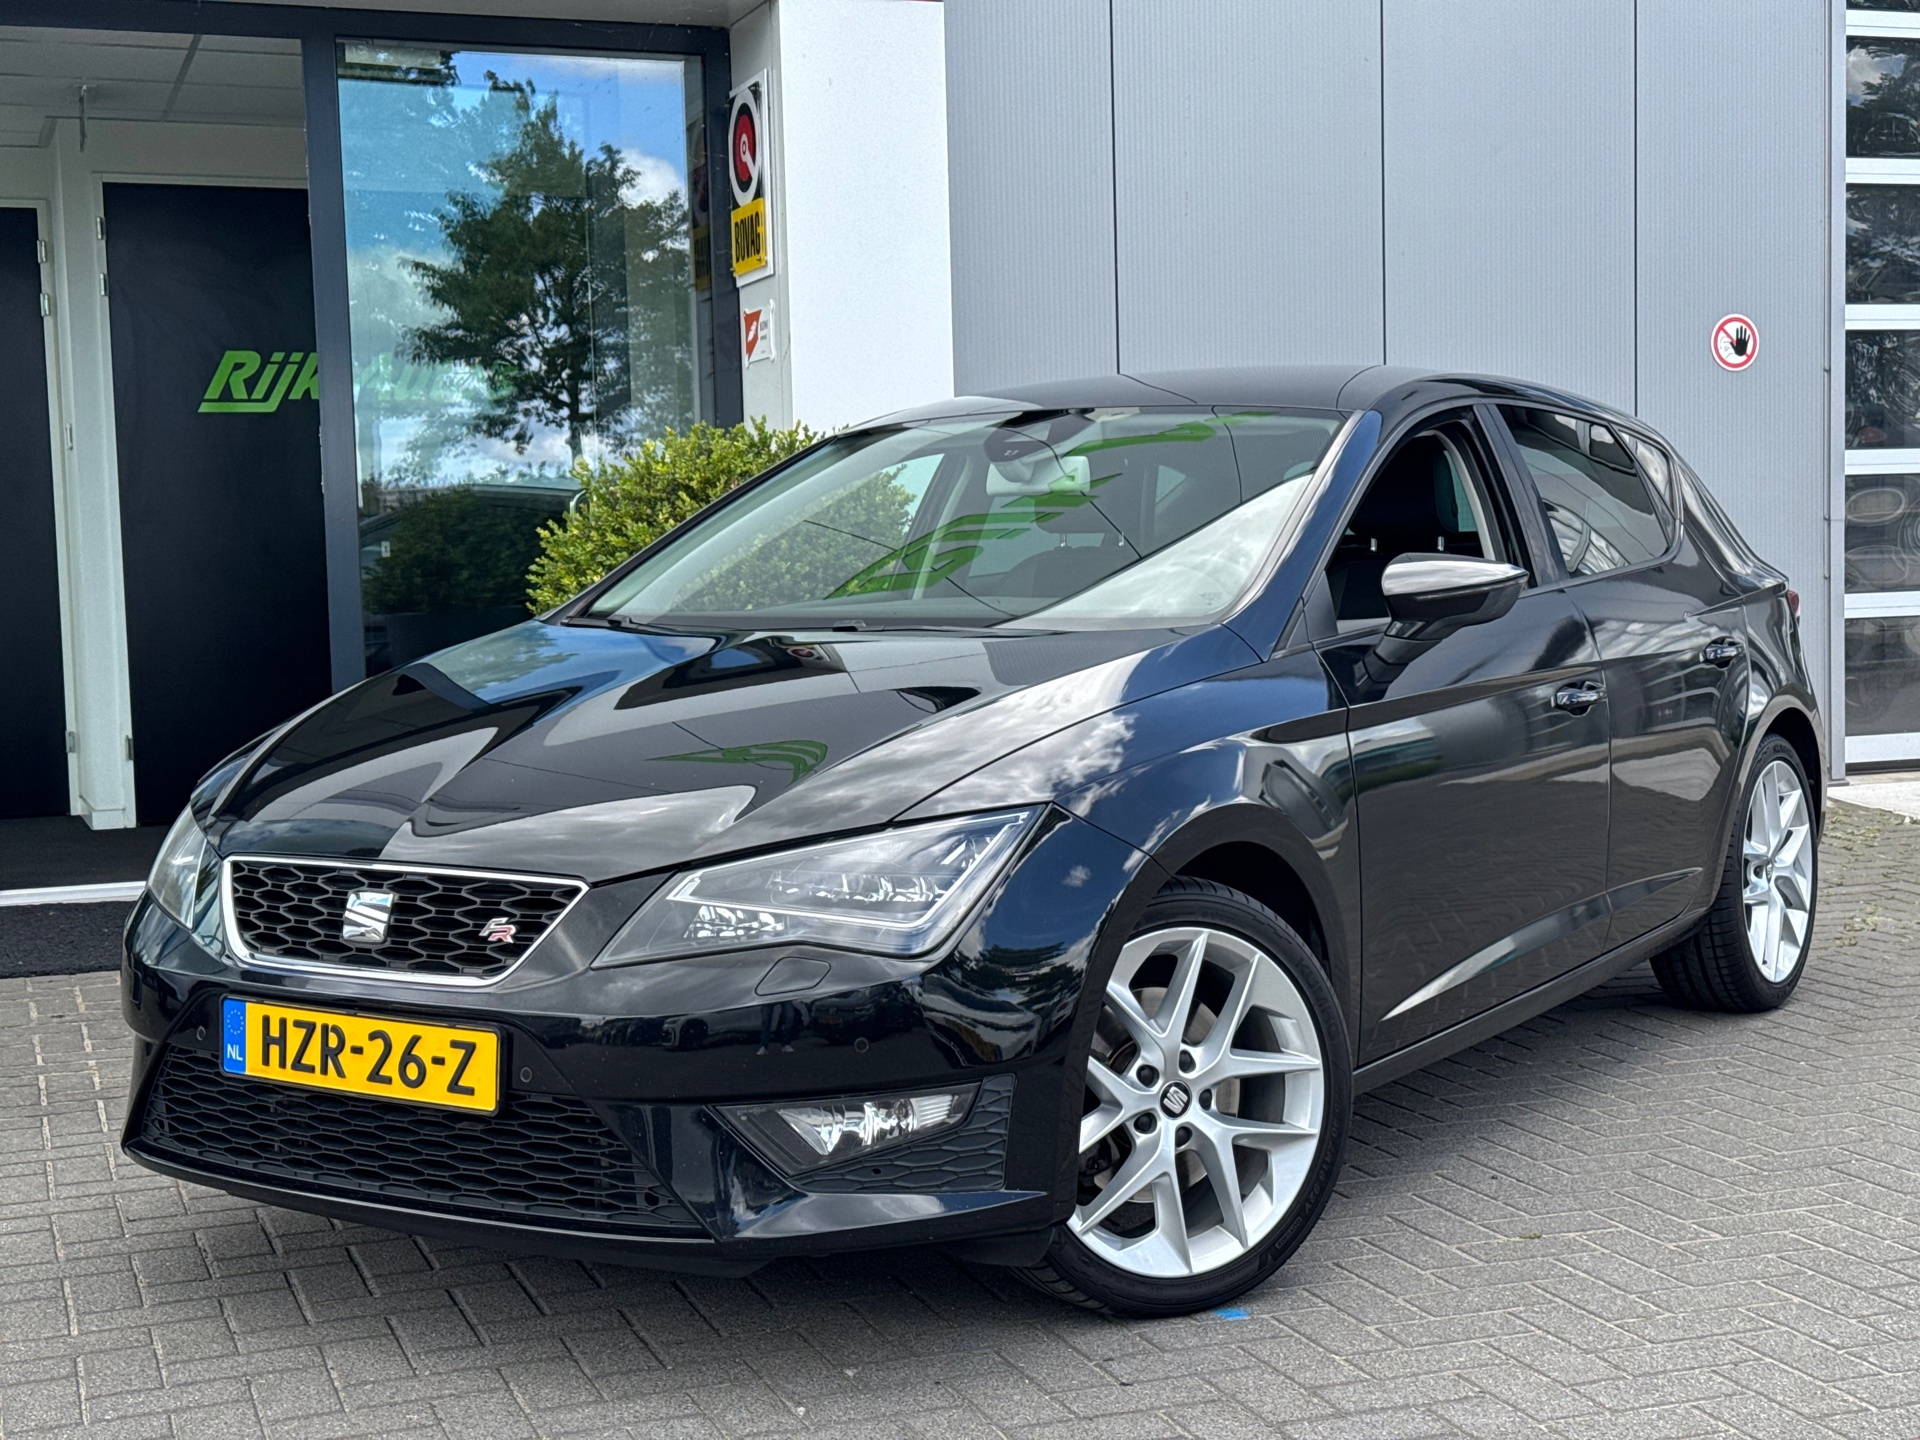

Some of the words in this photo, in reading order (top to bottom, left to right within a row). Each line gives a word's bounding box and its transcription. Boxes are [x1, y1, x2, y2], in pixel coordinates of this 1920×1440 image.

[734, 210, 761, 263] BOVAG
[478, 917, 517, 944] FR
[226, 1043, 244, 1061] NL
[261, 1014, 478, 1096] HZR-26-Z
[1304, 1183, 1321, 1215] 92Y
